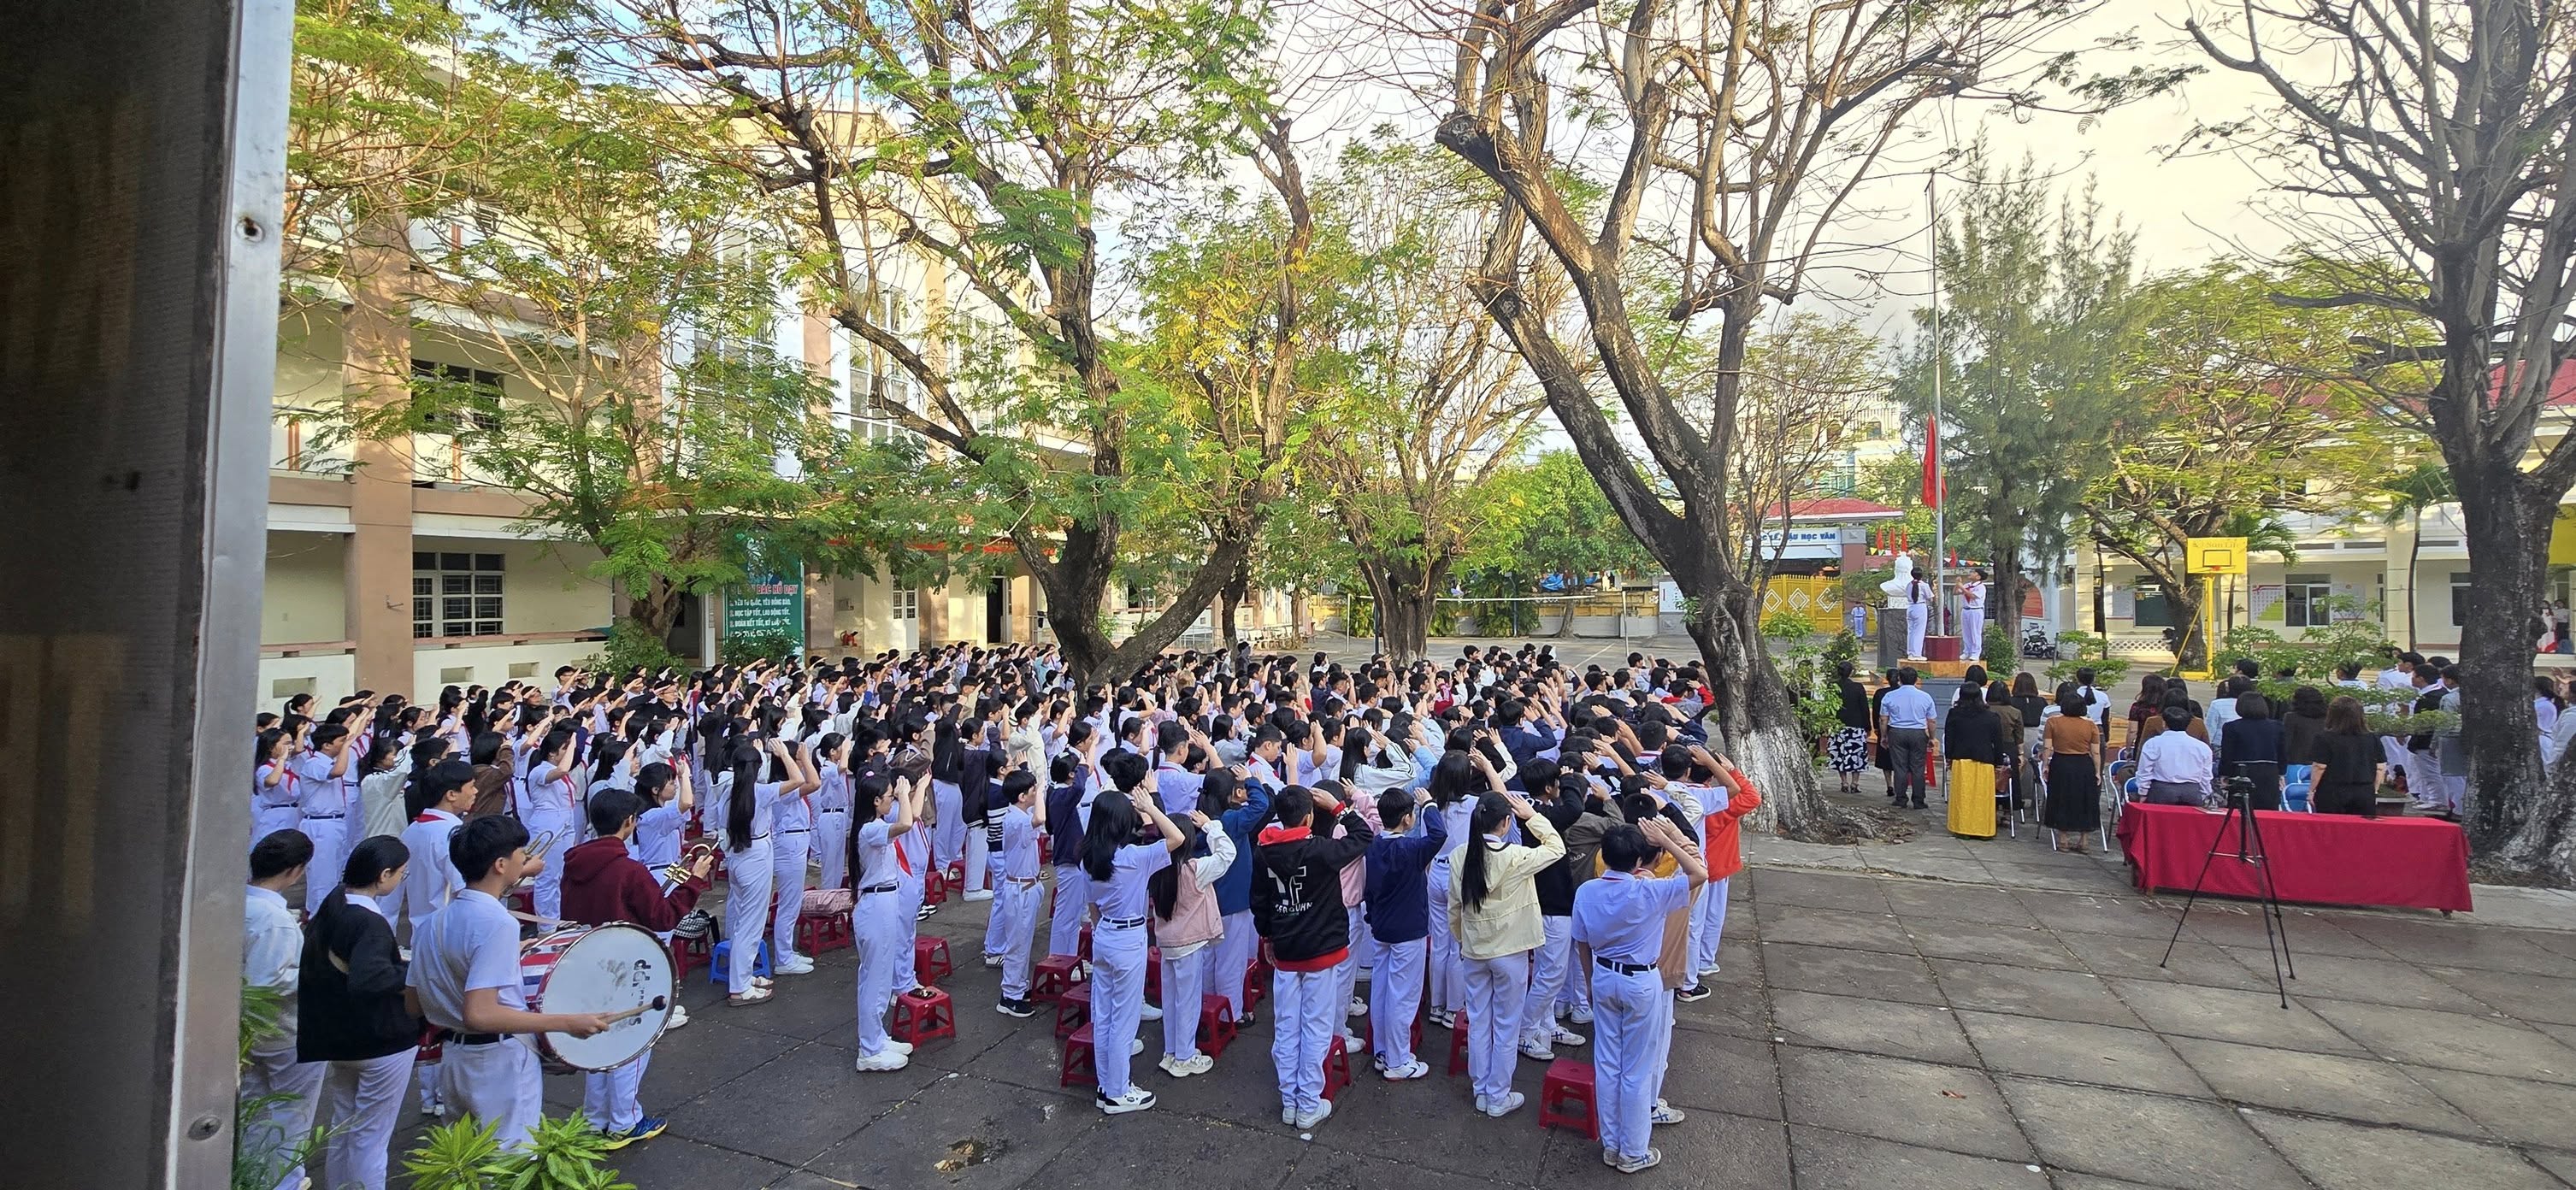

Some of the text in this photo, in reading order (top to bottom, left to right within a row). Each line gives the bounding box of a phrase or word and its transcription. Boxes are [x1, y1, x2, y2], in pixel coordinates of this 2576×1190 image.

[1789, 532, 1799, 541] ẬU
[756, 582, 771, 595] BÁC
[772, 581, 783, 595] HỒ
[783, 584, 799, 596] DẠY
